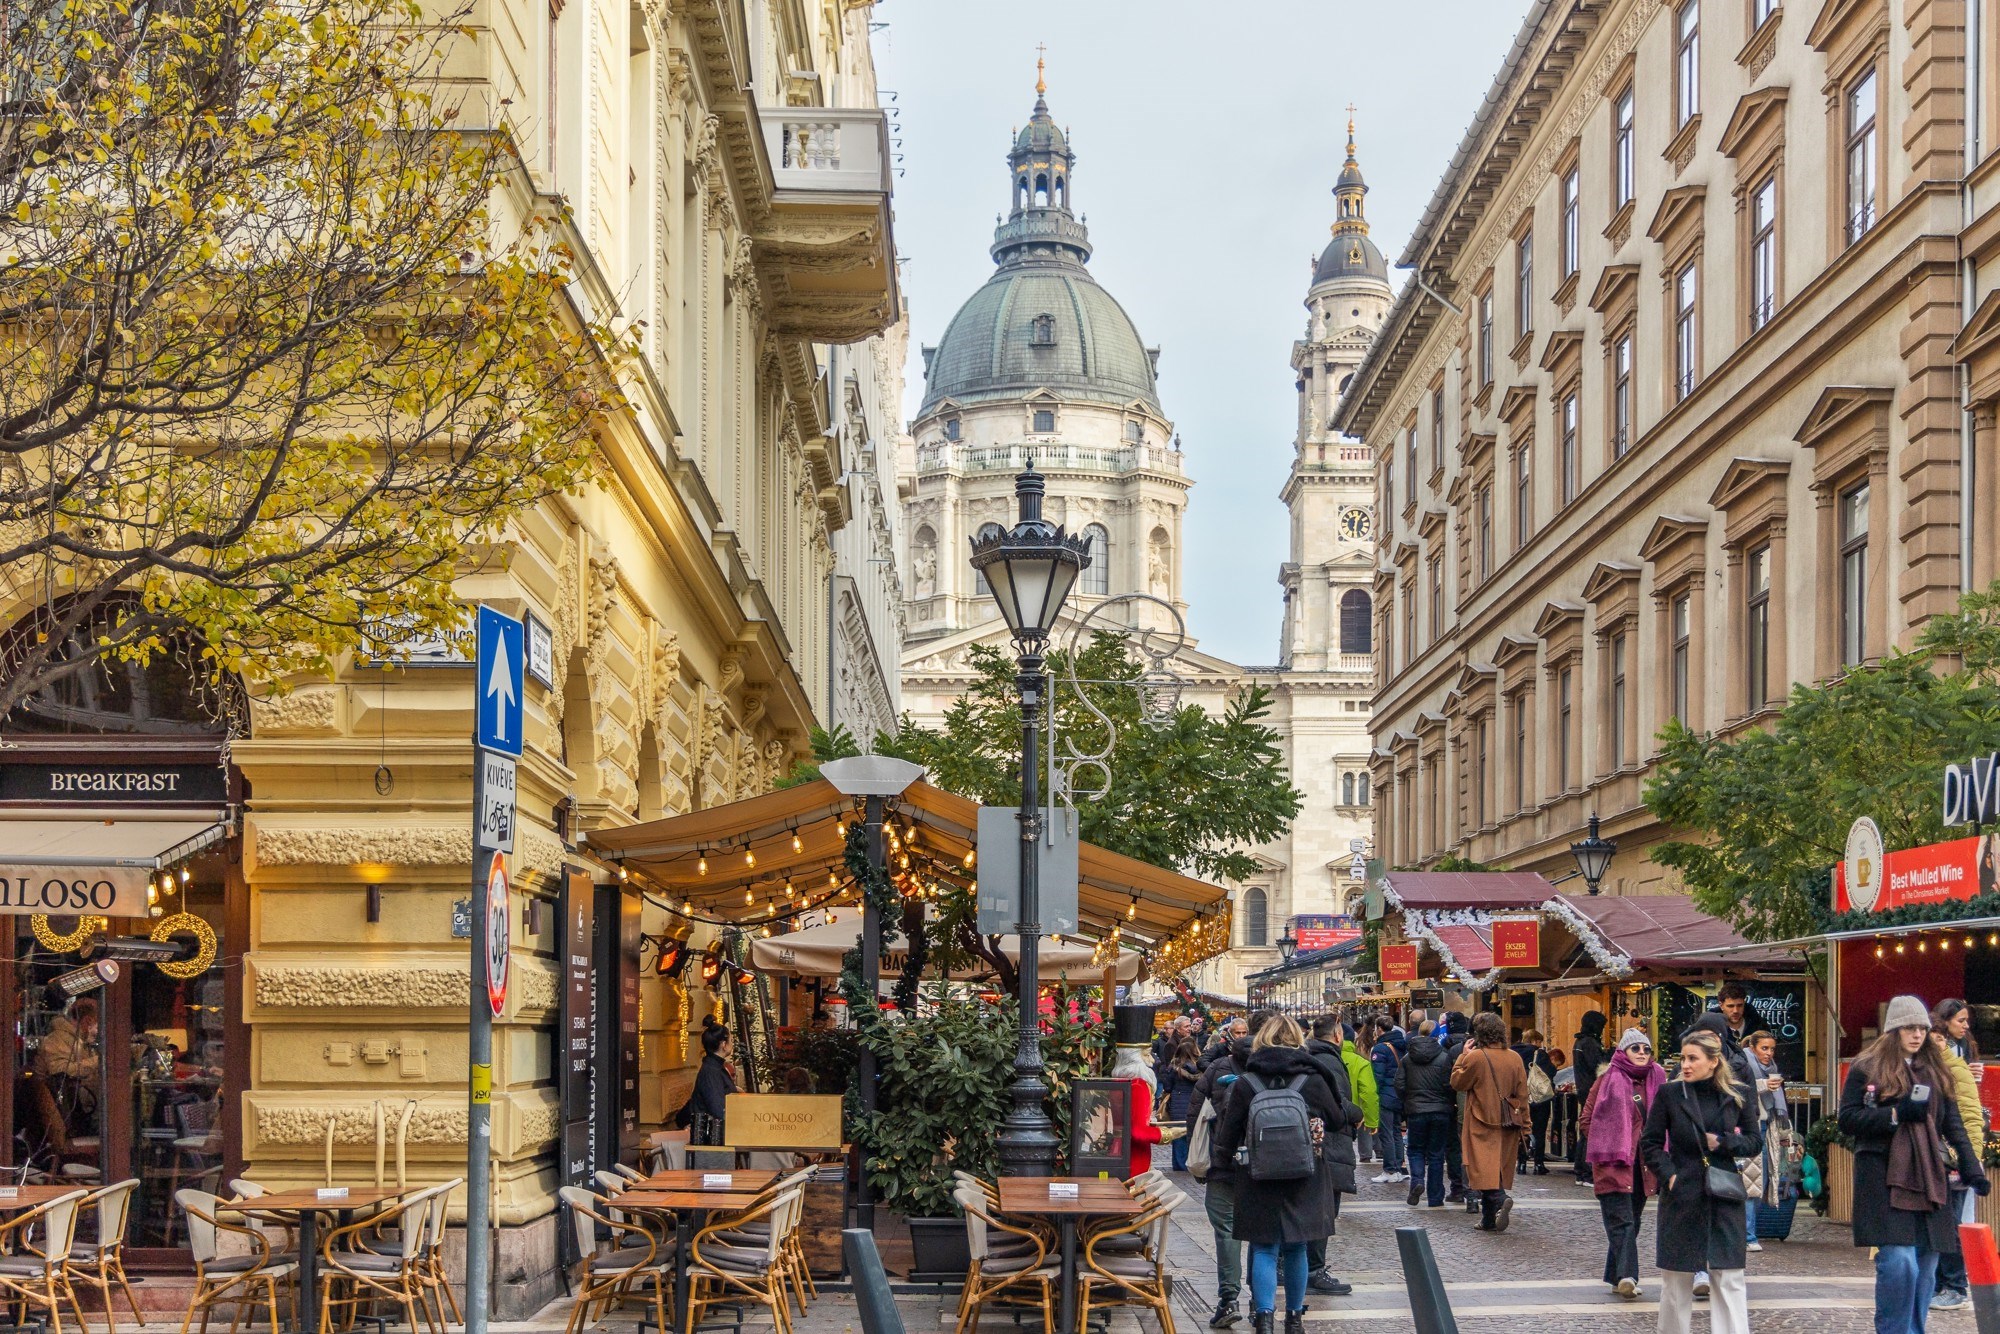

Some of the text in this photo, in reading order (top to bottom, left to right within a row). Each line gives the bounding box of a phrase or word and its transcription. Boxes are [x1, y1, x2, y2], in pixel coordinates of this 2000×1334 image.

[487, 762, 513, 791] KIVÉVE
[1891, 863, 1963, 890] Best Mulled Wine
[1913, 889, 1934, 898] Christmas
[1934, 886, 1950, 895] Market
[492, 905, 504, 966] 30
[1505, 942, 1526, 950] ÉKSZER
[1067, 962, 1078, 970] BY
[753, 1112, 813, 1123] NONLOSO
